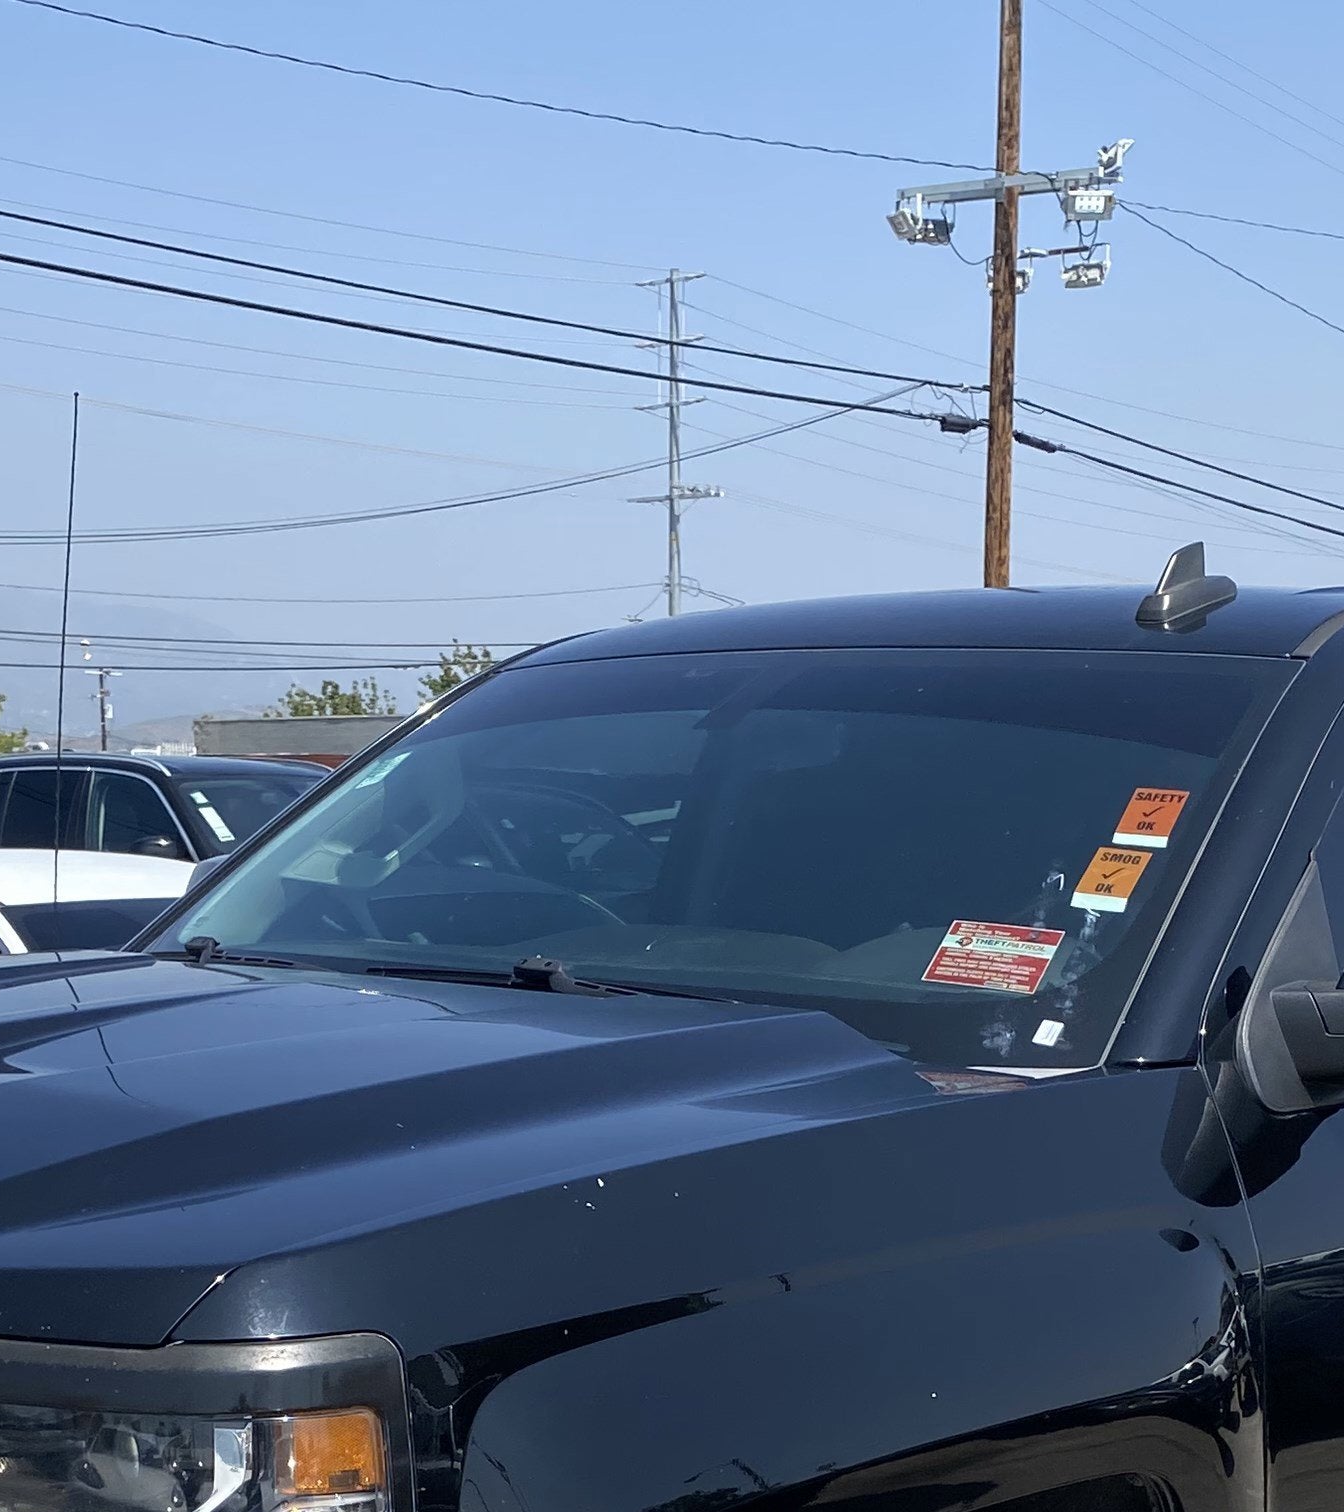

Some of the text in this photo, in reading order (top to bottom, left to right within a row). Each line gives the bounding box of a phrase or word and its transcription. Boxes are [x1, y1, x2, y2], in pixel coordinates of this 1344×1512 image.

[1134, 792, 1186, 803] SAFETY
[1136, 820, 1156, 831] OK
[1099, 851, 1142, 865] SMOG
[1095, 882, 1114, 894] OK
